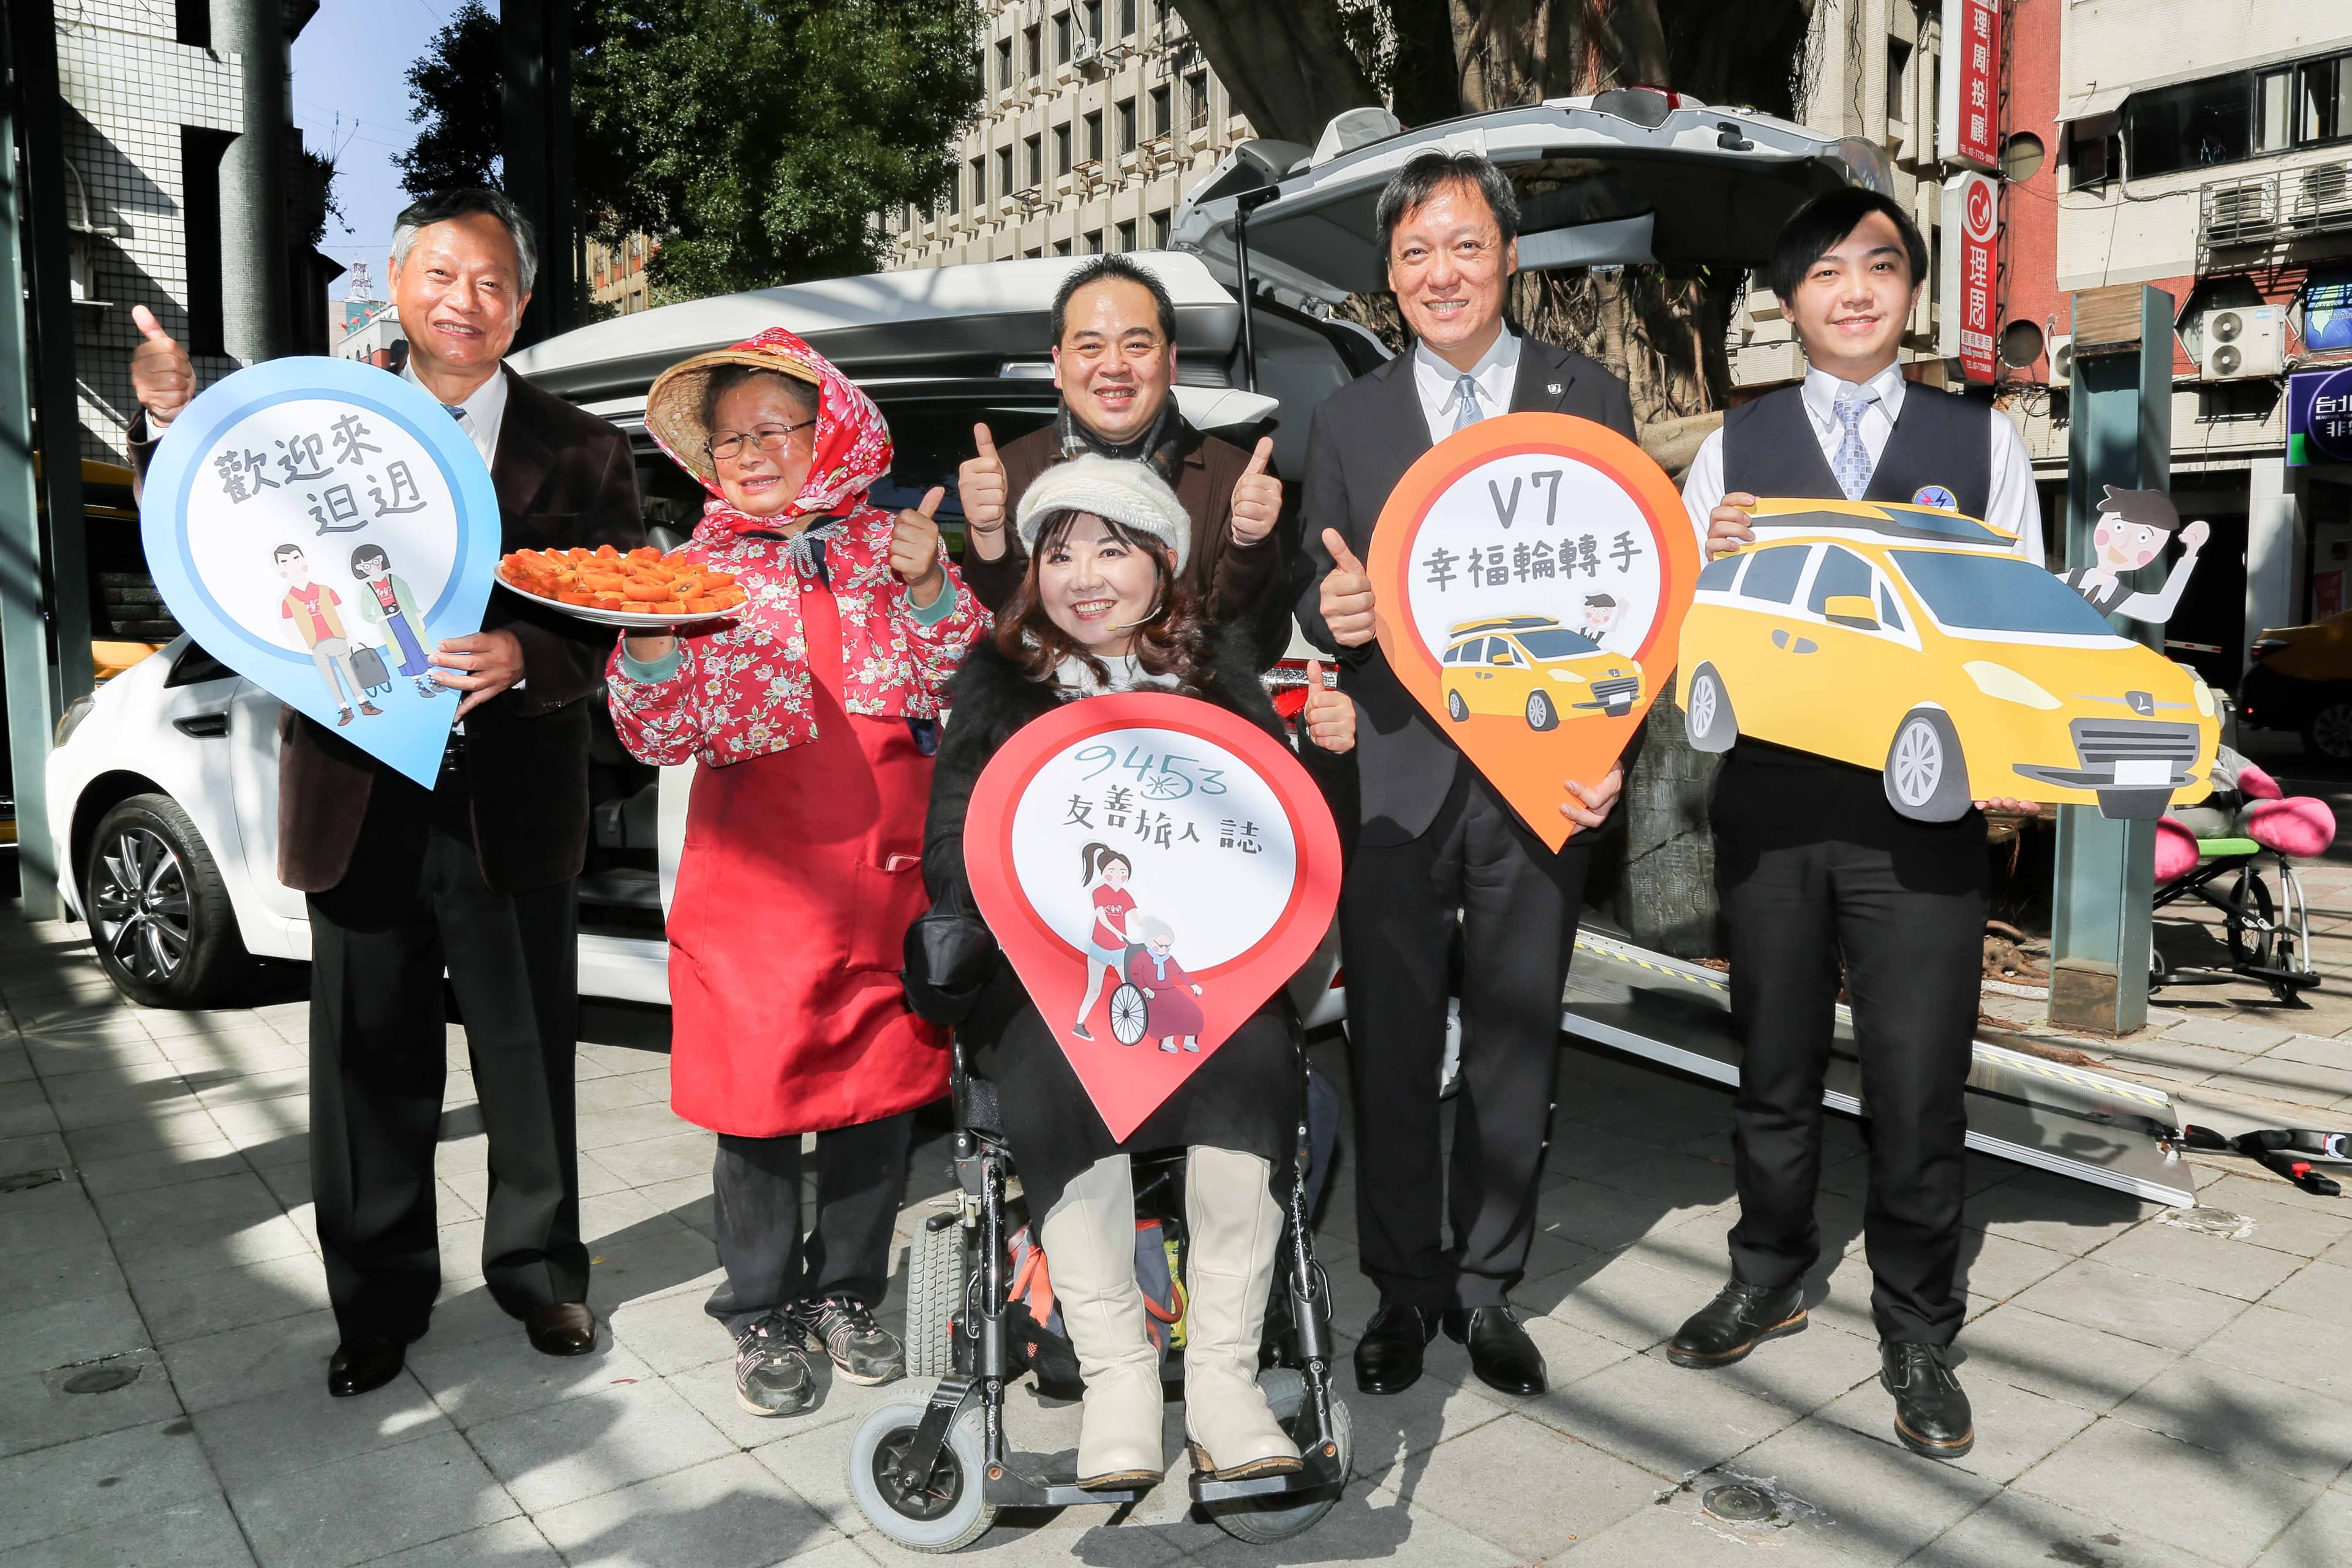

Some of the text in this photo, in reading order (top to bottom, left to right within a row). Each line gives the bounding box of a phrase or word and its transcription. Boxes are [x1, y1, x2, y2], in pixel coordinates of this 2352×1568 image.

[1970, 8, 1987, 145] 理周投顧
[1969, 245, 1987, 330] 理周
[214, 414, 382, 503] 歡迎來
[1488, 470, 1563, 529] V7
[1422, 530, 1643, 592] 幸福輪轉手
[1074, 745, 1228, 801] 9453
[1063, 784, 1263, 855] 友善旅人誌
